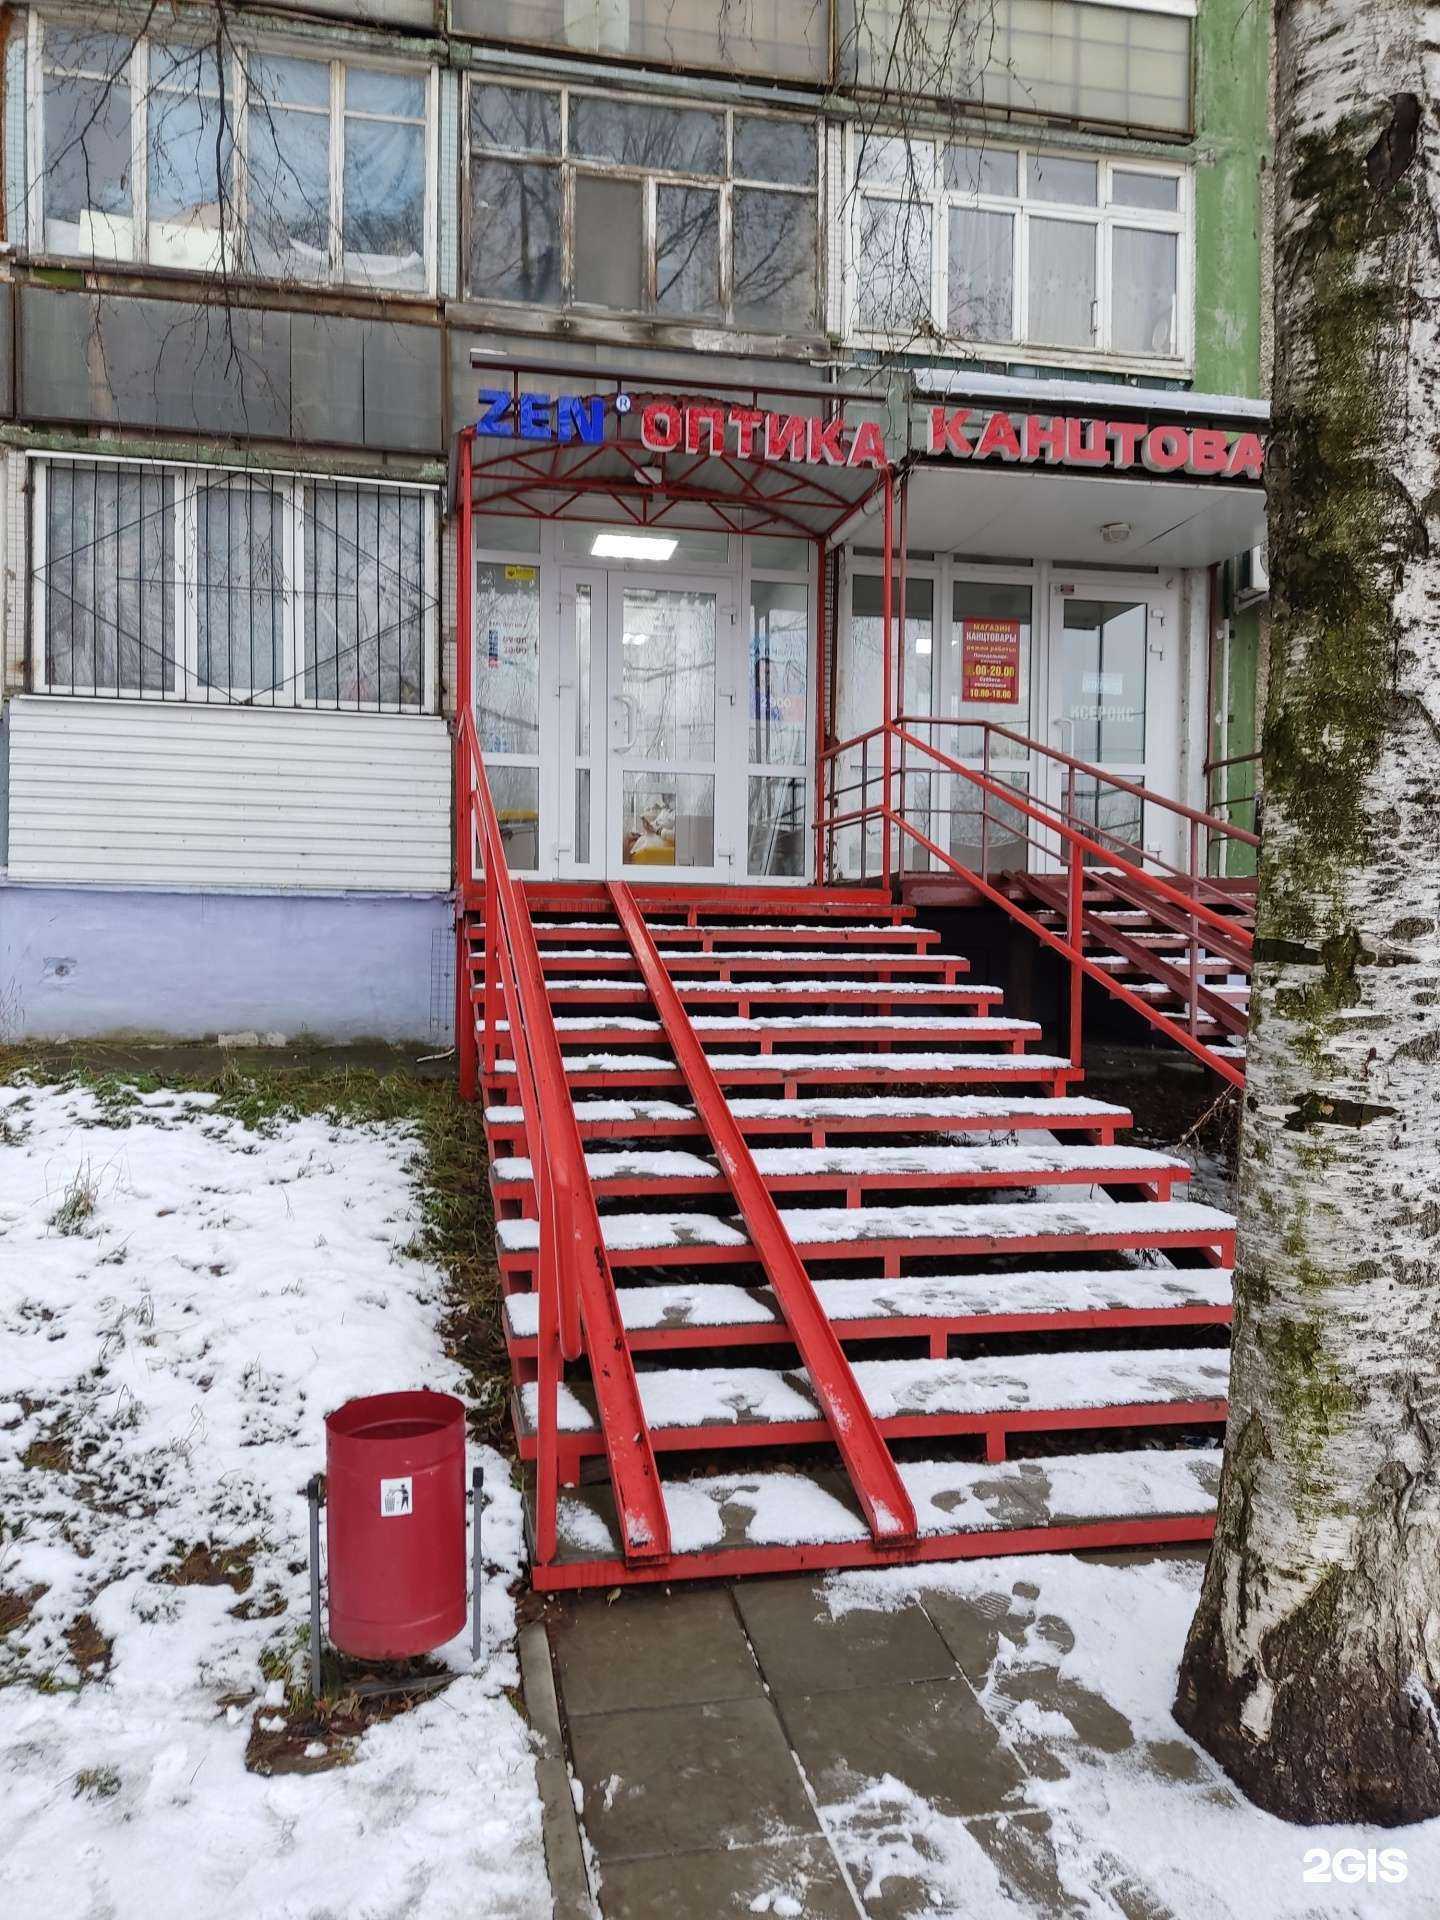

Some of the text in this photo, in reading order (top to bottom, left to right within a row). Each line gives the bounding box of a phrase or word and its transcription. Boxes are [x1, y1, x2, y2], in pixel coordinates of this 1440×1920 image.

[476, 388, 605, 445] ZEN
[640, 402, 888, 468] ОПТИКА
[974, 624, 1010, 632] МАГАЗИН
[966, 632, 1017, 643] КАНЦТОВАРЫ
[1070, 705, 1134, 722] КСЕРОКС
